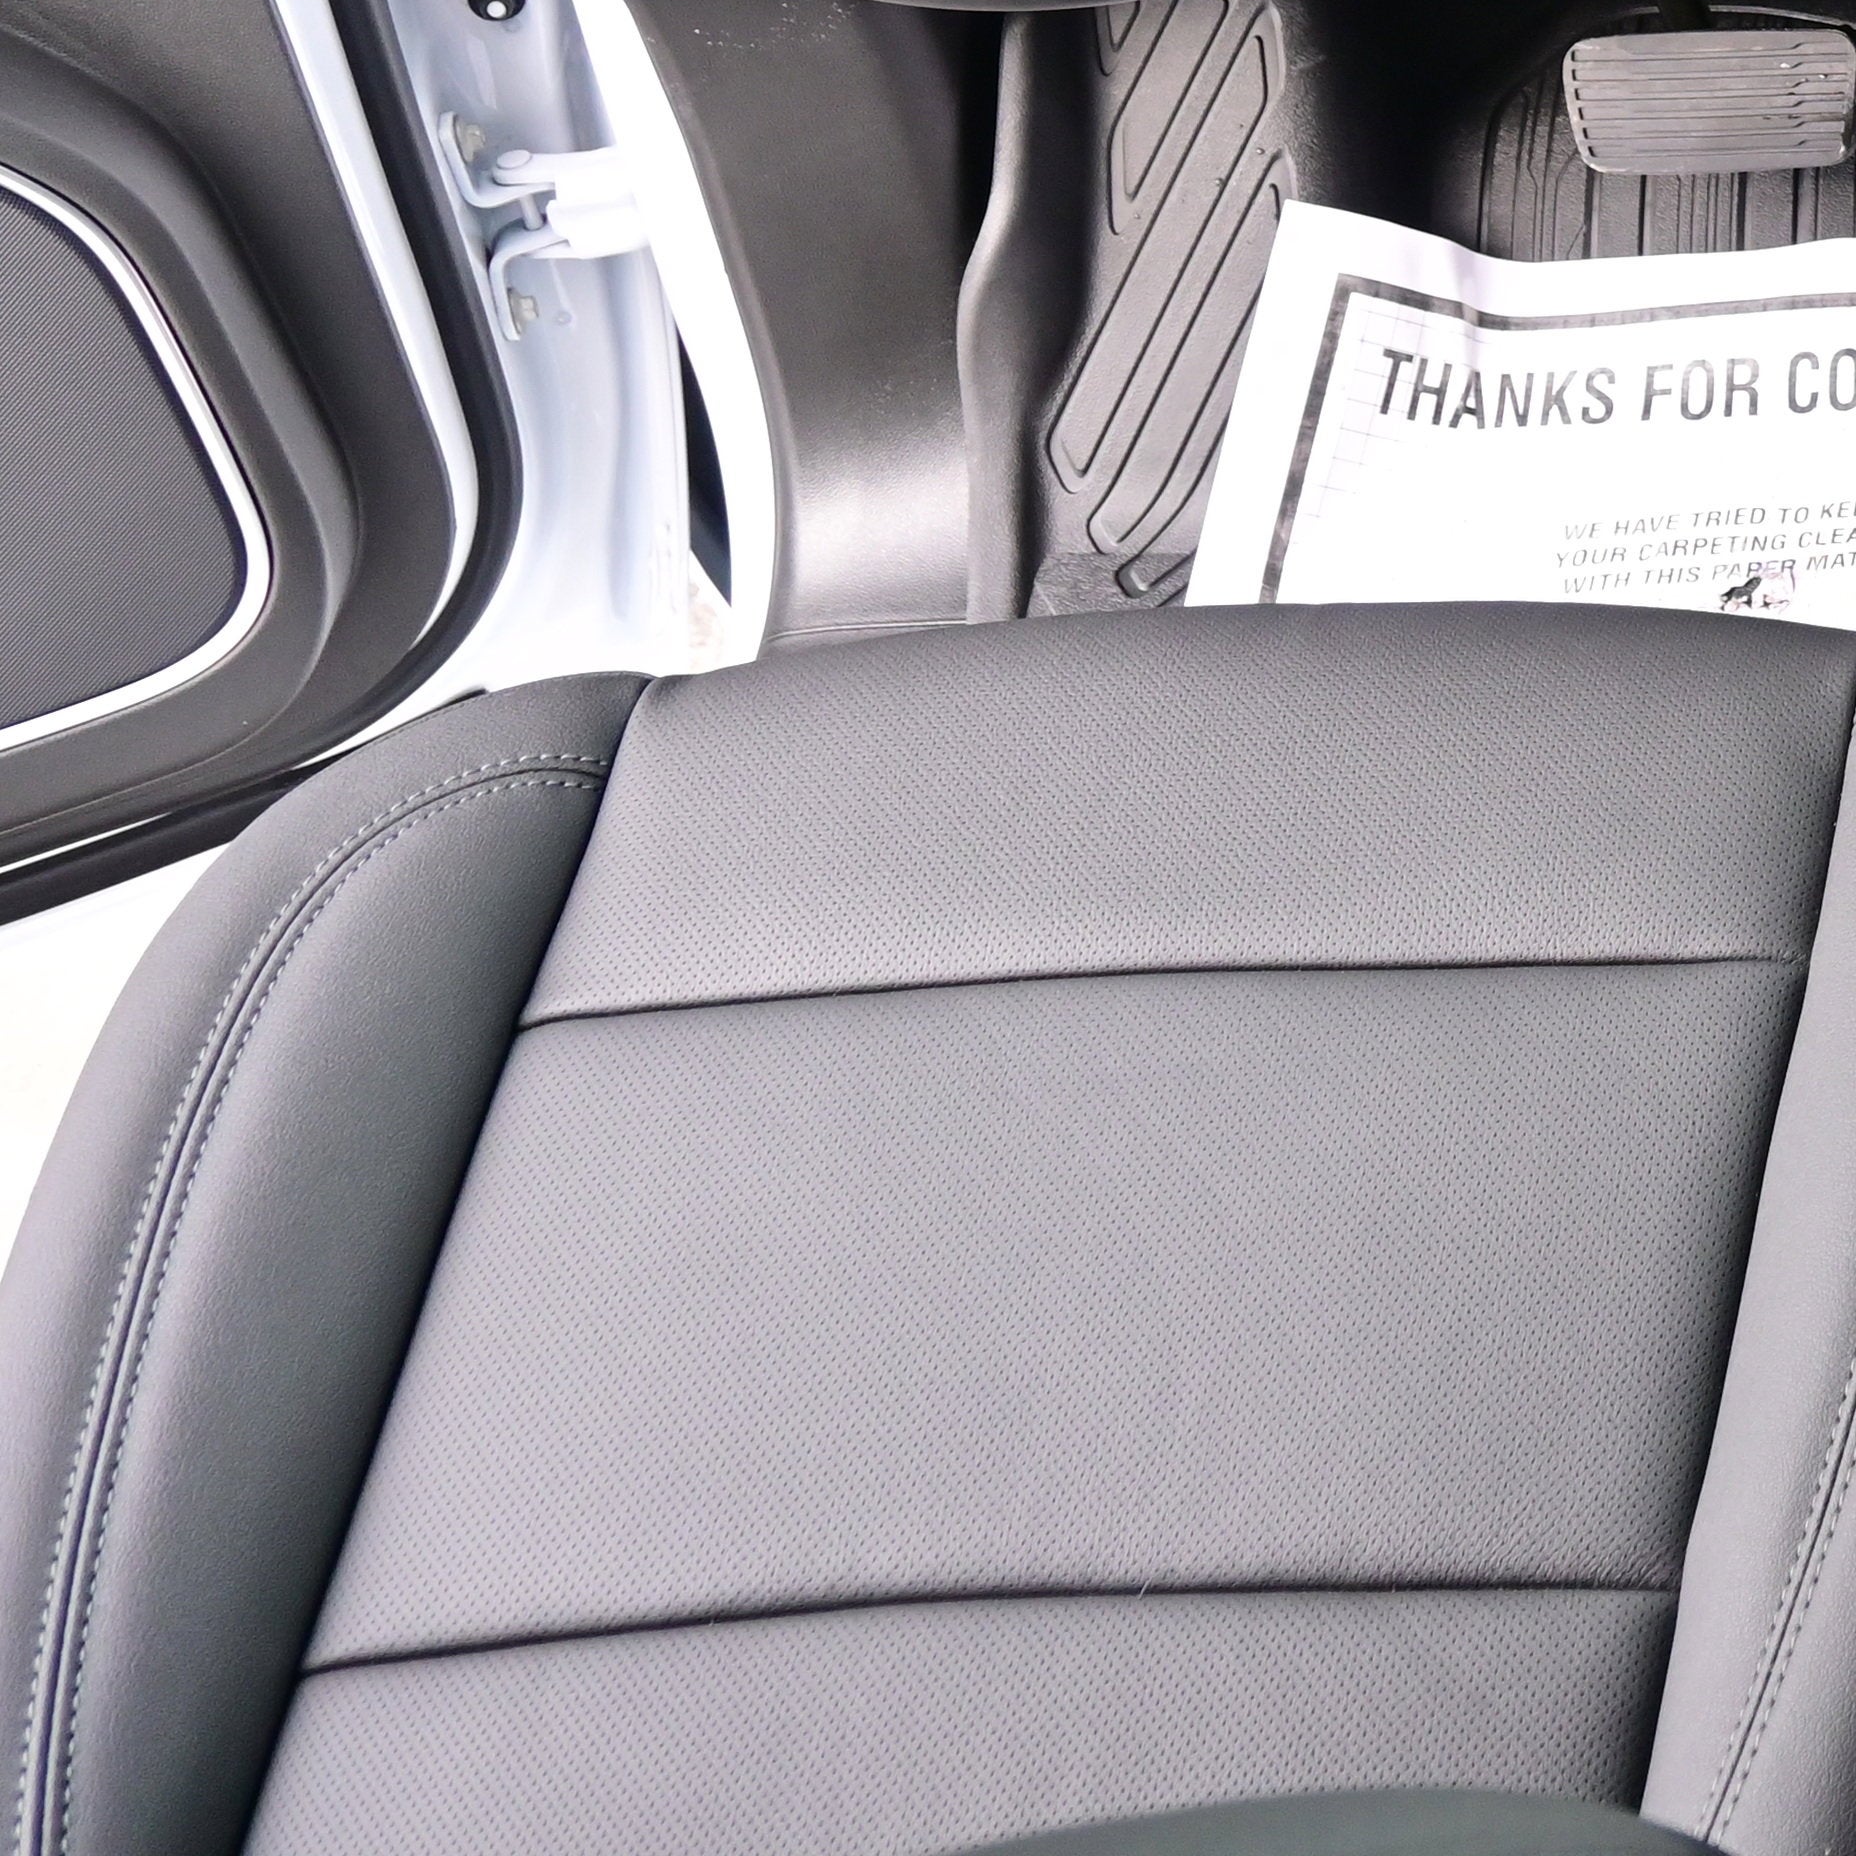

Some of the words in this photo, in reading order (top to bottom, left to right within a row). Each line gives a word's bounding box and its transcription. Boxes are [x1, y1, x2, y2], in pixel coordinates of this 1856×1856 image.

[1379, 347, 1616, 429] THANKS
[1640, 357, 1759, 421] FOR
[1565, 522, 1602, 541] WE
[1613, 514, 1680, 539] HAVE
[1691, 507, 1766, 528] TRIED
[1778, 506, 1810, 525] TO
[1556, 547, 1627, 569] YOUR
[1639, 534, 1786, 562] CARPETING
[1563, 571, 1631, 594] WITH
[1644, 566, 1701, 585] THIS
[1712, 558, 1797, 580] PAPER
